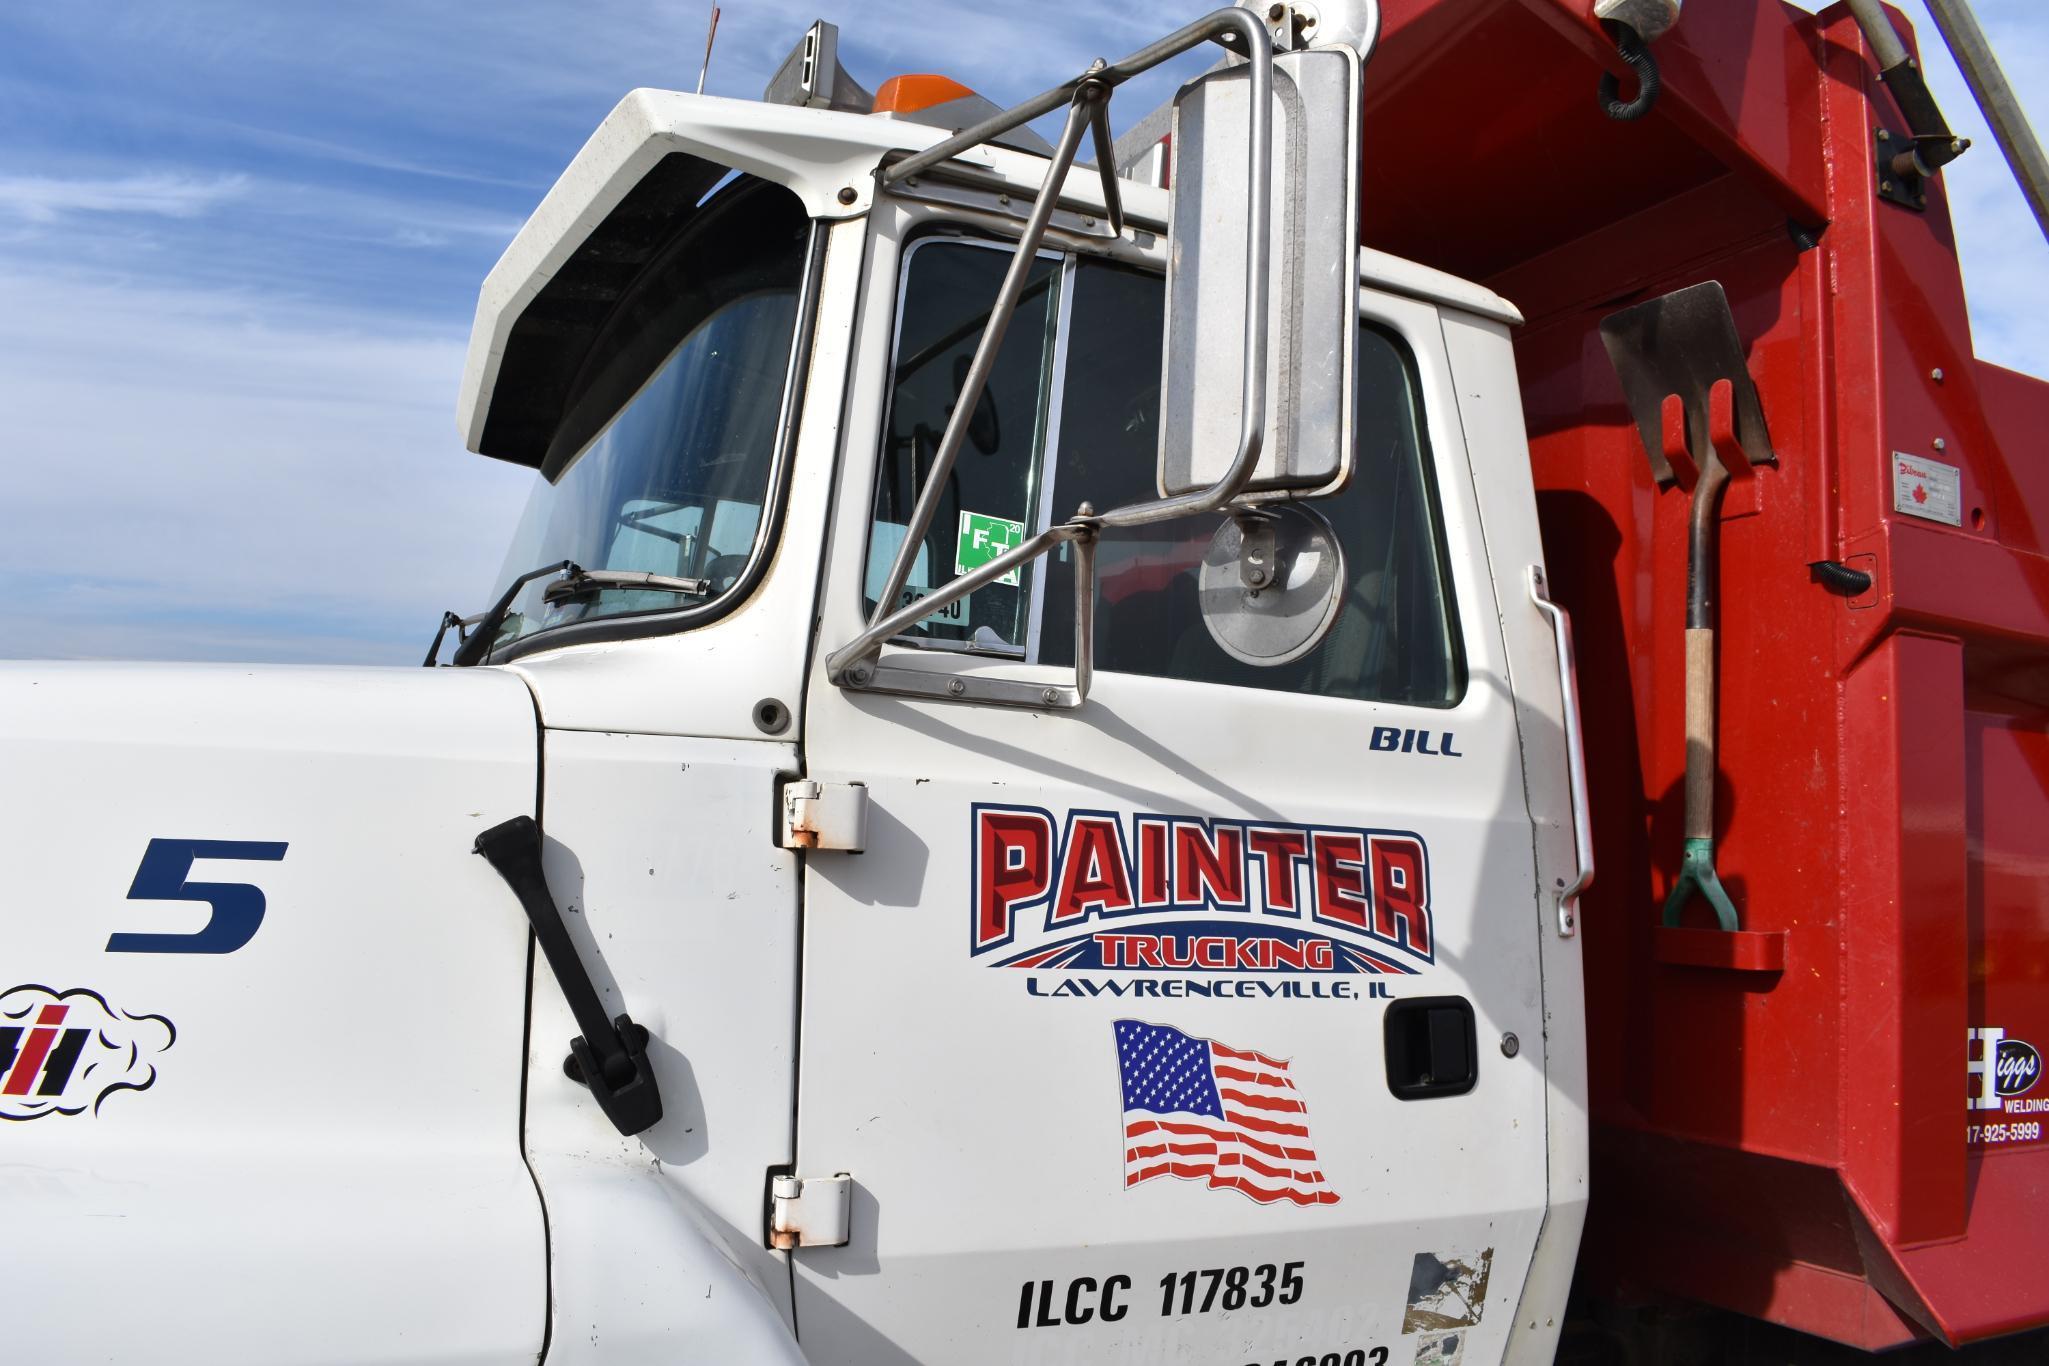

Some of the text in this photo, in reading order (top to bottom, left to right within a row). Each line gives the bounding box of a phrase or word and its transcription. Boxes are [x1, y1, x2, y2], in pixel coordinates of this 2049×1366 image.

[1009, 523, 1020, 534] 20
[1369, 726, 1462, 757] BILL
[105, 838, 289, 954] 5
[971, 802, 1435, 966] PAINTER
[1093, 934, 1334, 970] TRUCKING
[1026, 977, 1358, 1001] LAWRENCEVILLE,
[1369, 981, 1396, 999] IL
[2004, 1098, 2049, 1113] WELDING
[1017, 1261, 1305, 1329] ILCC 117835
